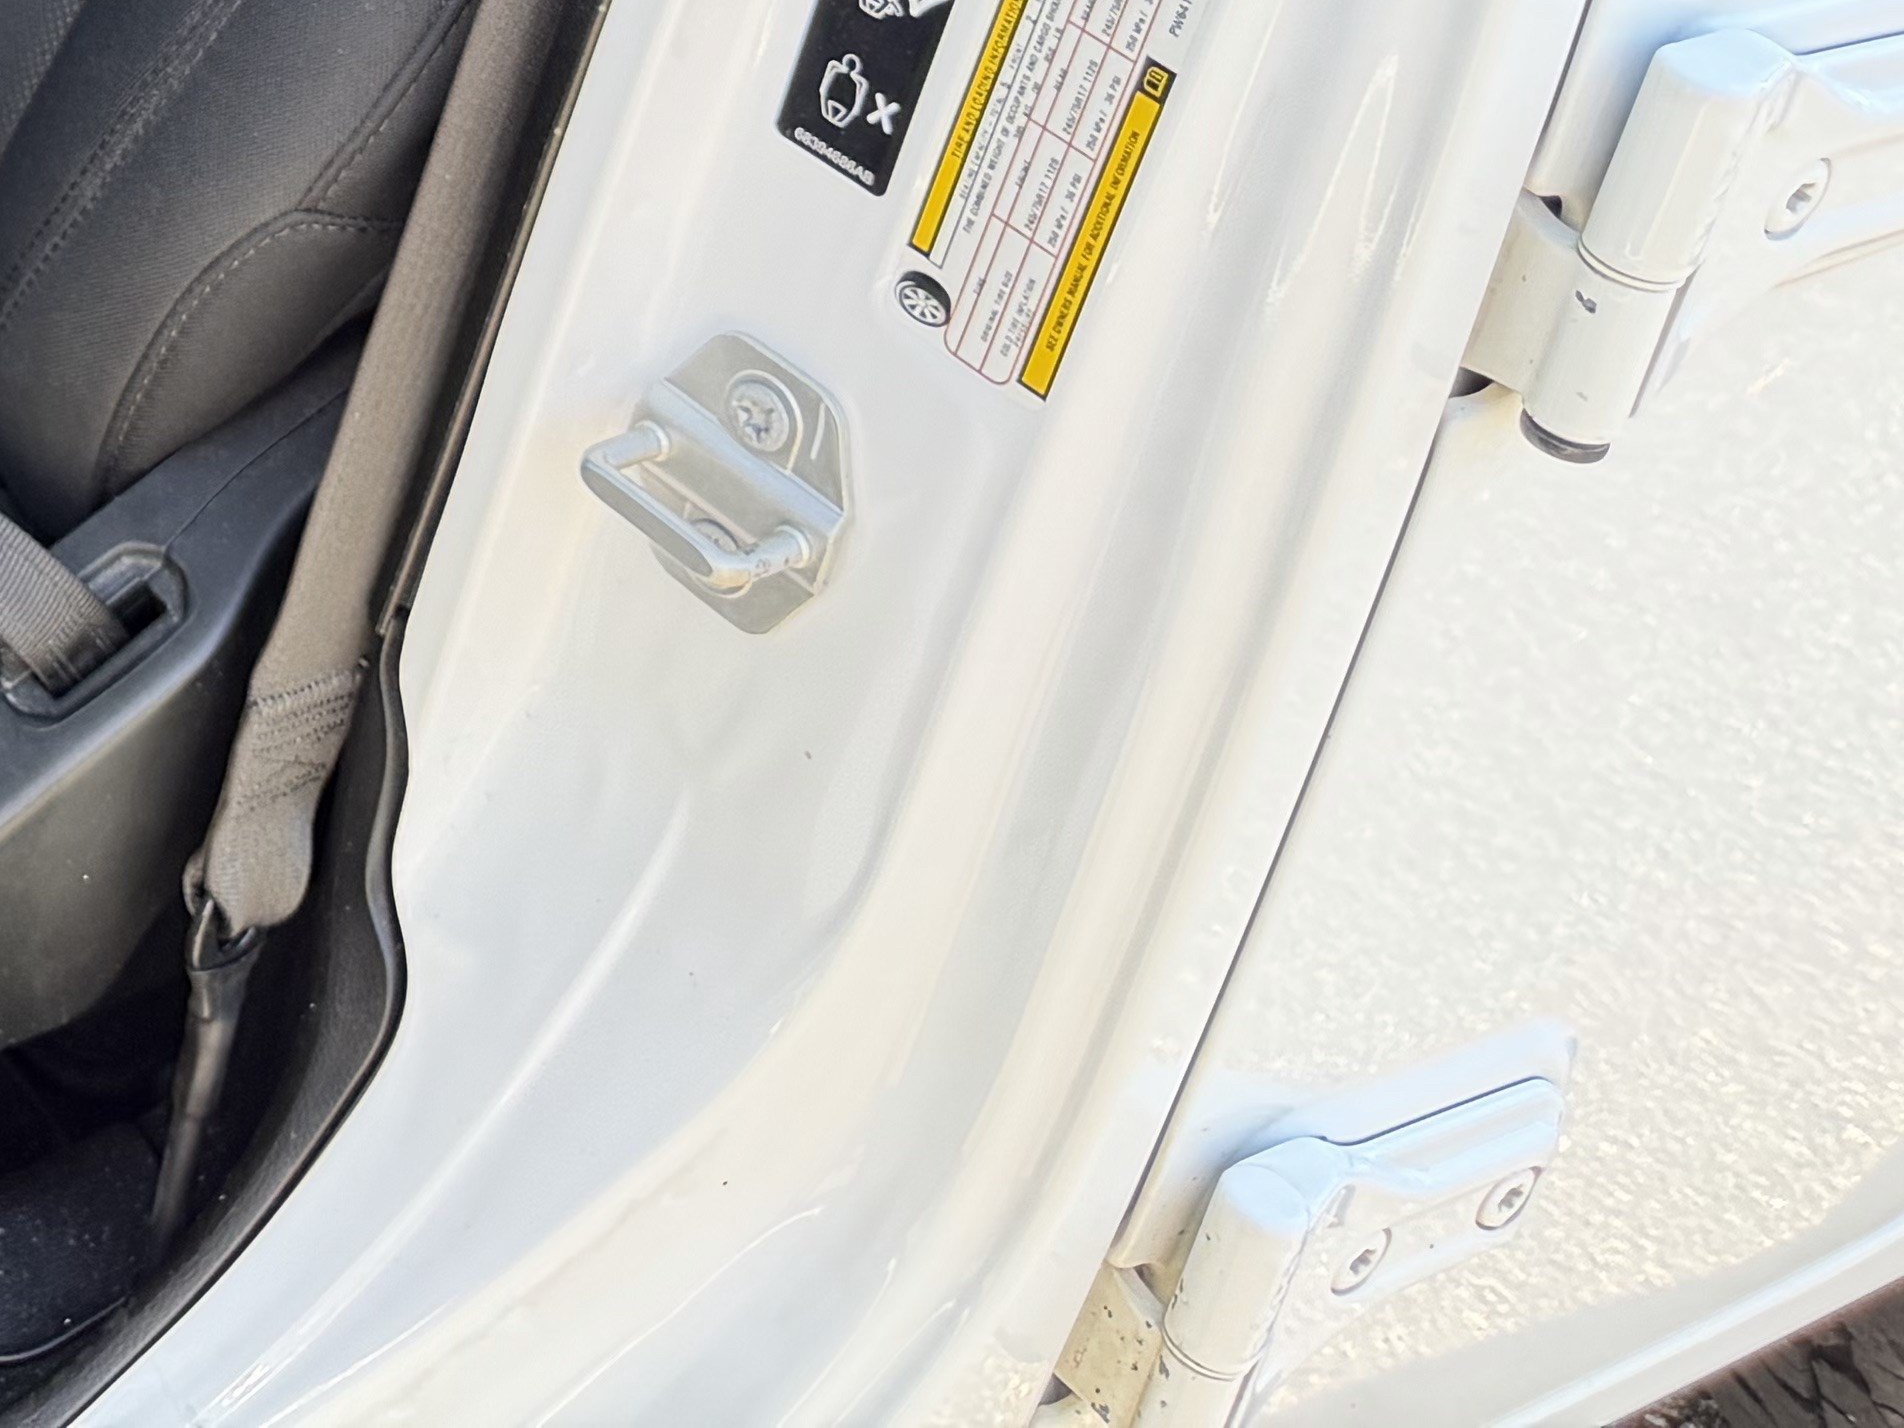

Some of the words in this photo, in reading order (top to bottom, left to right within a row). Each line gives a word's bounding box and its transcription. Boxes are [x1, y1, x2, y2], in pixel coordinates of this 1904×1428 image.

[950, 134, 966, 159] TIRE
[961, 110, 976, 134] AND
[969, 66, 995, 113] LOADING
